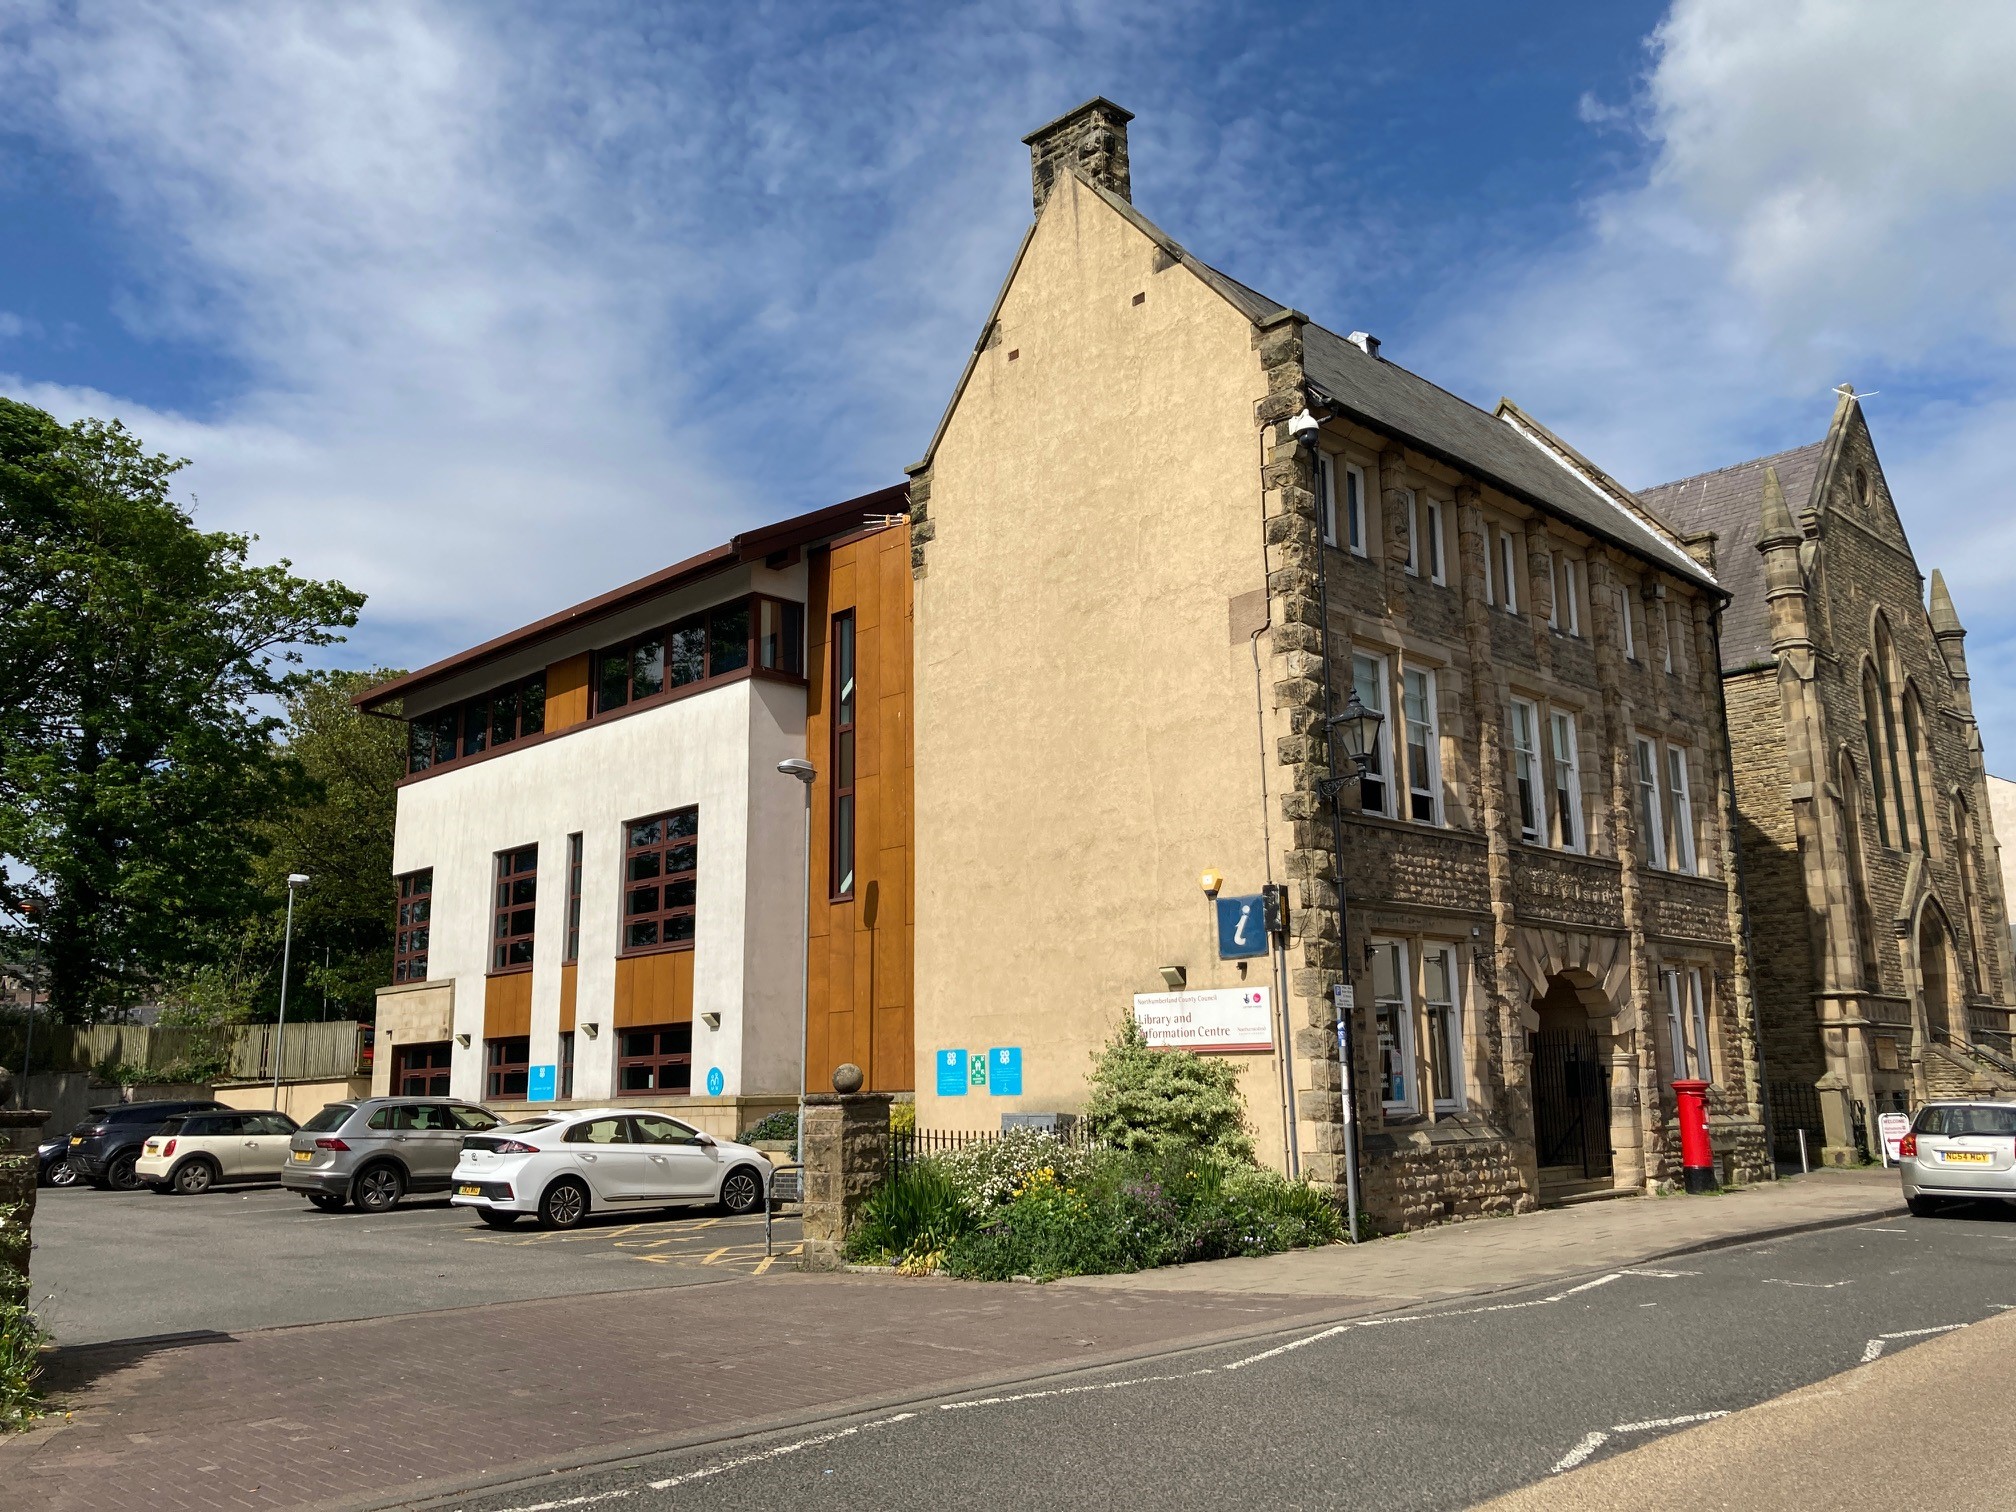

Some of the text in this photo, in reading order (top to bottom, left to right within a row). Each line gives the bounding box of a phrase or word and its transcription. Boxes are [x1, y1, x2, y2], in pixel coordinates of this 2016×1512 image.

[1234, 905, 1250, 945] i
[1138, 994, 1217, 1005] Northumberland County Council
[1138, 1012, 1192, 1026] Library and
[1198, 1026, 1230, 1037] Centre
[1946, 1152, 1967, 1160] NG54
